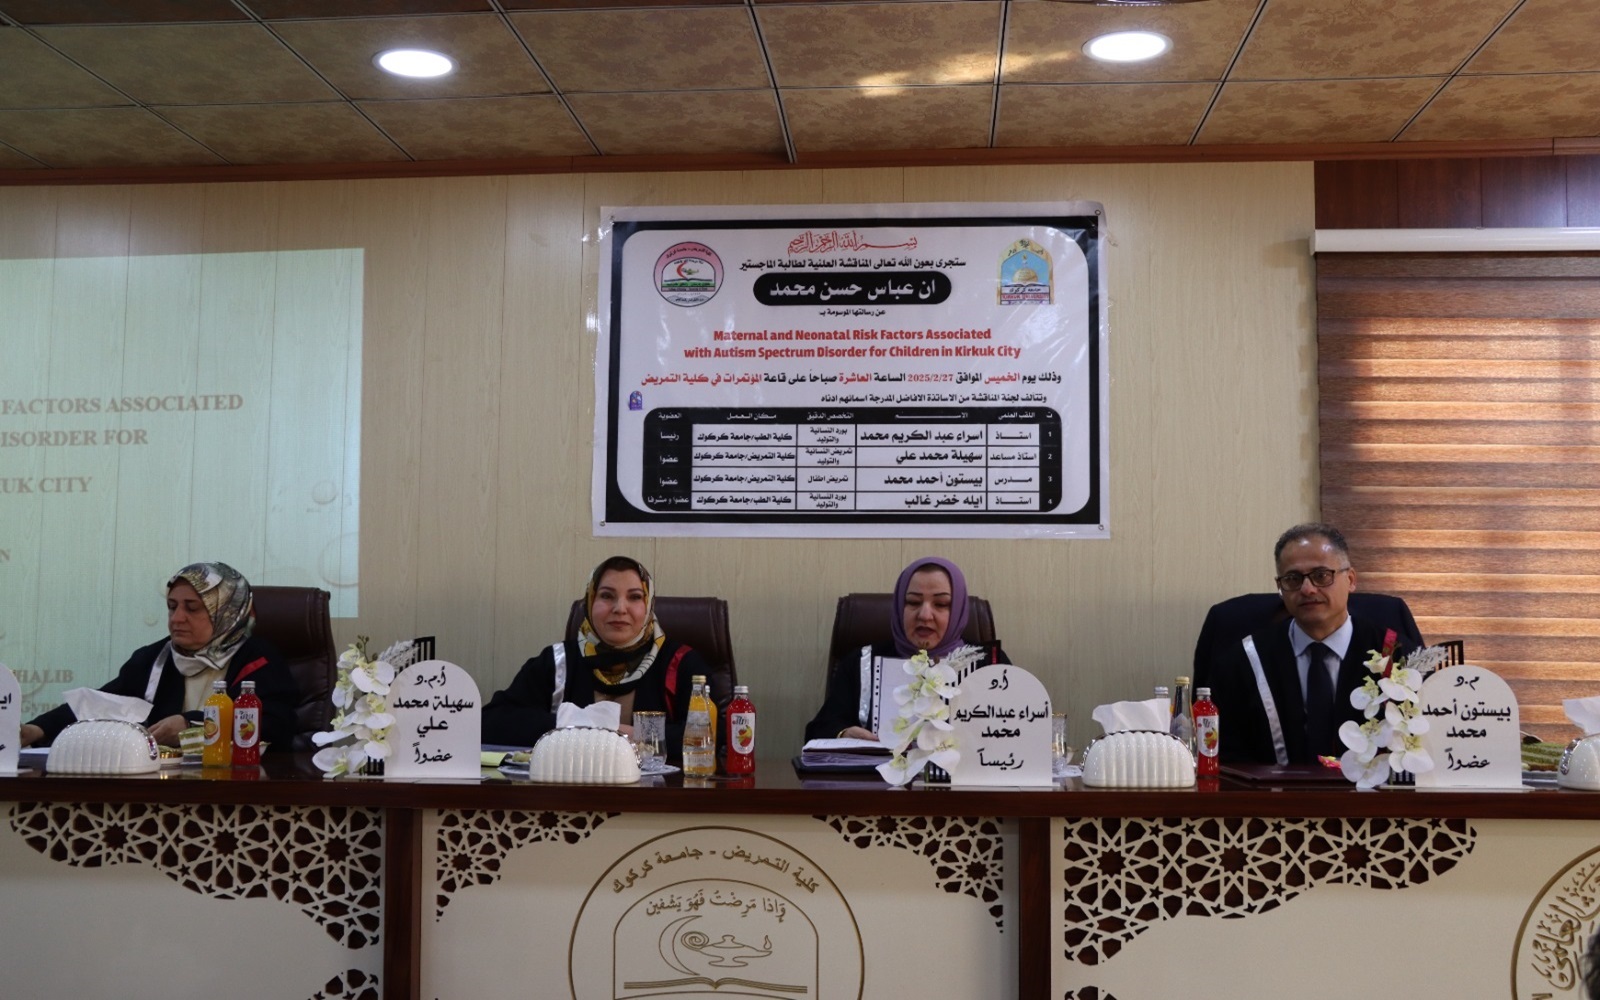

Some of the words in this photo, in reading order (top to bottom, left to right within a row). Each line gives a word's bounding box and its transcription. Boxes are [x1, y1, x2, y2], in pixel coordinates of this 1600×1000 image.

[740, 260, 776, 271] الماجستير
[778, 259, 806, 270] لطالبة
[808, 259, 837, 270] العلنية
[839, 258, 872, 269] المناقشة
[873, 258, 896, 269] تعالى
[898, 258, 912, 268] الله
[914, 258, 934, 270] بعون
[936, 258, 966, 270] ستجرى
[770, 282, 816, 297] محمد
[820, 282, 862, 301] حسن
[868, 279, 914, 301] عباس
[918, 279, 936, 300] ان
[827, 308, 851, 317] الموسومة
[852, 308, 874, 317] رسالتها
[714, 330, 768, 341] Maternal
[770, 330, 793, 340] and
[796, 329, 852, 340] Neonatal
[853, 329, 878, 340] Risk
[881, 329, 924, 340] Factors
[926, 328, 992, 340] Associated
[684, 347, 712, 358] with
[714, 347, 756, 358] Autism
[758, 346, 815, 360] Spectrum
[817, 346, 868, 358] Disorder
[870, 346, 887, 357] for
[890, 346, 940, 357] Children
[942, 346, 952, 356] in
[955, 346, 994, 357] Kirkuk
[998, 346, 1021, 359] City
[641, 374, 680, 386] التمريض
[683, 373, 709, 385] كلية
[710, 374, 722, 386] في
[724, 373, 762, 385] المؤتمرات
[764, 372, 786, 382] قاعة
[788, 374, 806, 384] على
[839, 372, 872, 384] العاشرة
[874, 372, 906, 382] الساعة
[908, 374, 954, 382] 2025/2/27
[956, 372, 982, 384] الموافق
[984, 372, 1020, 384] الخميس
[1022, 374, 1036, 384] يوم
[1038, 372, 1062, 384] وذلك
[820, 394, 838, 402] ادناه
[869, 394, 894, 404] المدرجة
[958, 394, 970, 404] من
[972, 392, 1000, 402] المناقشة
[1002, 393, 1019, 404] لجنة
[2, 397, 101, 415] FACTORS
[106, 394, 244, 412] ASSOCIATED
[658, 412, 682, 420] العضوية
[0, 430, 97, 447] ISORDER
[104, 429, 148, 446] FOR
[697, 432, 729, 442] كركوك
[730, 432, 772, 442] الطب/جامعة
[773, 432, 792, 442] كلية
[860, 431, 889, 441] محمد
[892, 430, 932, 443] الكريم
[935, 430, 954, 442] عبد
[956, 430, 983, 442] اسراء
[660, 454, 678, 464] عضوا
[694, 452, 724, 461] كركوك
[777, 452, 796, 461] كلية
[896, 450, 917, 465] علي
[918, 450, 949, 462] محمد
[952, 450, 983, 463] سهيلة
[990, 452, 1016, 460] مساعد
[660, 476, 678, 486] عضوا
[694, 474, 724, 484] كركوك
[776, 474, 795, 484] كلية
[826, 475, 848, 484] تمريض
[884, 475, 913, 485] محمد
[916, 472, 944, 484] أحمد
[946, 474, 983, 488] بيستون
[39, 476, 93, 494] CITY
[696, 496, 728, 506] كركوك
[730, 496, 771, 506] الطب/جامعة
[772, 496, 792, 506] كلية
[904, 494, 932, 507] غالب
[934, 494, 960, 508] خضر
[963, 494, 983, 506] ايله
[392, 697, 429, 710] محمد
[432, 694, 474, 714] سهيلة
[1422, 698, 1458, 716] أحمد
[1018, 700, 1049, 722] أسراء
[1460, 702, 1511, 722] بيستون
[416, 716, 448, 738] علي
[981, 726, 1021, 738] محمد
[1446, 726, 1487, 739] محمد
[654, 846, 704, 864] جامعة
[722, 845, 790, 873] التمريض
[613, 860, 654, 894] كركوك
[792, 866, 820, 894] كلية
